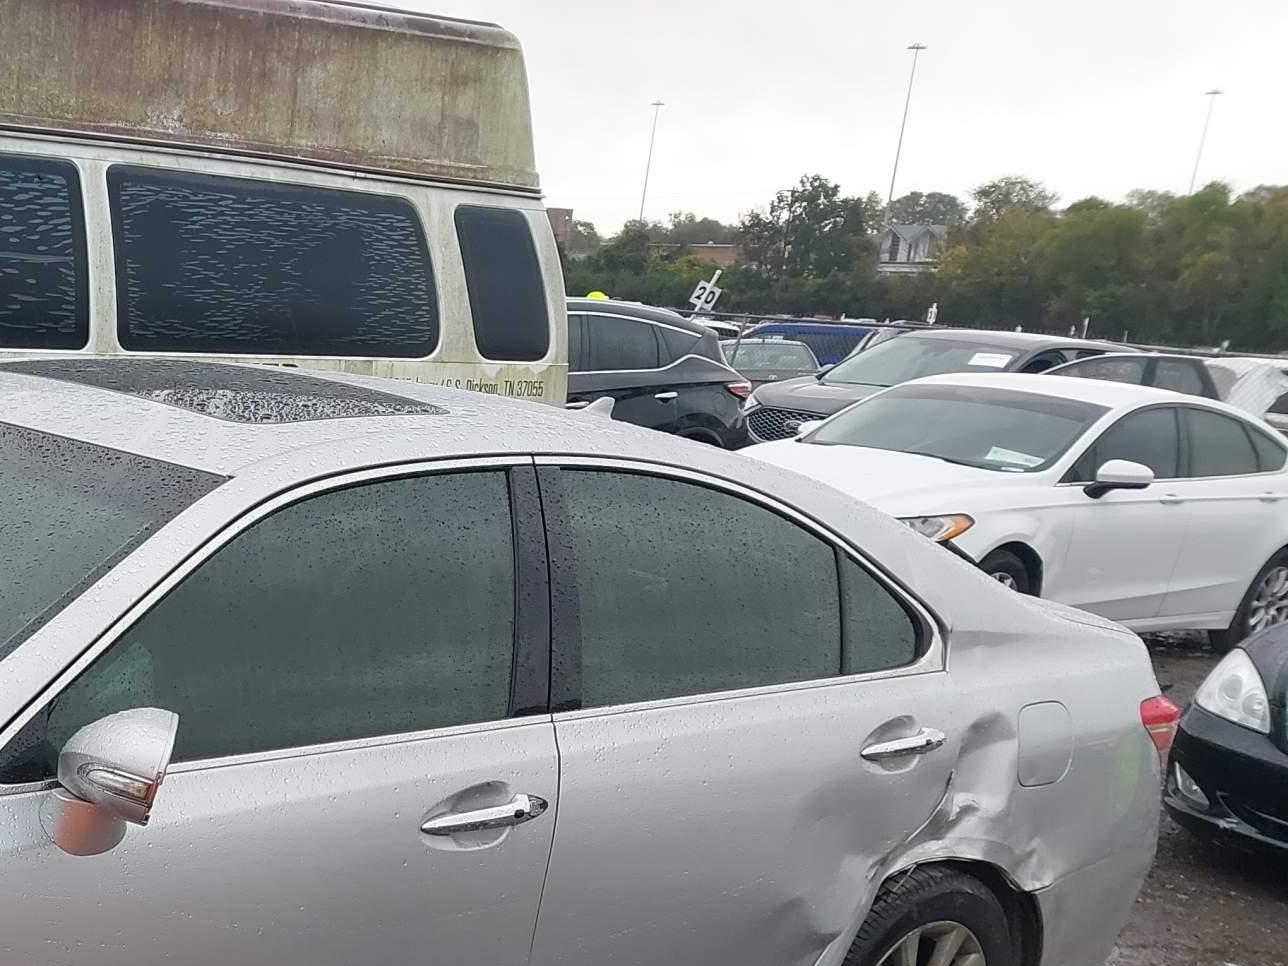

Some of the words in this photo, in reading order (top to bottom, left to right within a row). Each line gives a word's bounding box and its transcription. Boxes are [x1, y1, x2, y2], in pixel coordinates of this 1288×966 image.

[693, 286, 716, 305] 20
[504, 380, 515, 397] TN
[516, 380, 545, 397] 37055
